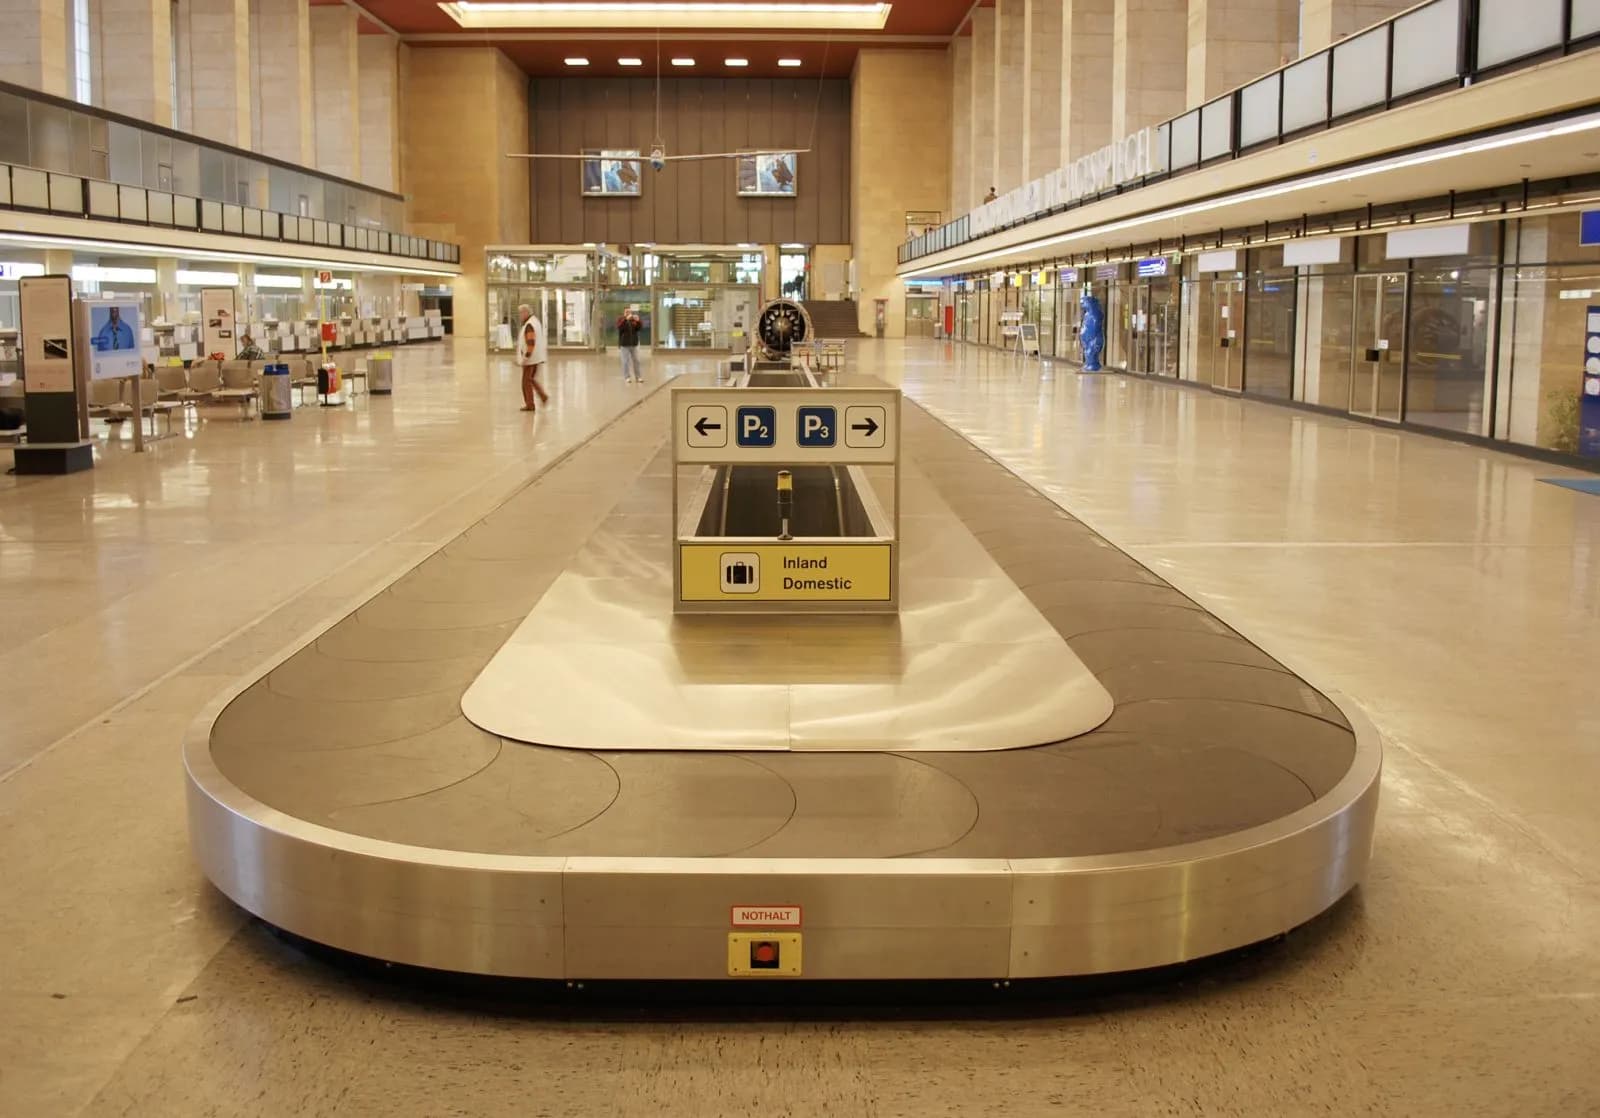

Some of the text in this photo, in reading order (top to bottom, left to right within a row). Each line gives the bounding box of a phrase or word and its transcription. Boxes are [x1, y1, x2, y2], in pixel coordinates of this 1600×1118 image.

[743, 415, 829, 438] P2 P3
[783, 556, 827, 569] Inland
[783, 577, 852, 590] Domestic
[742, 911, 791, 920] NOTHALT
